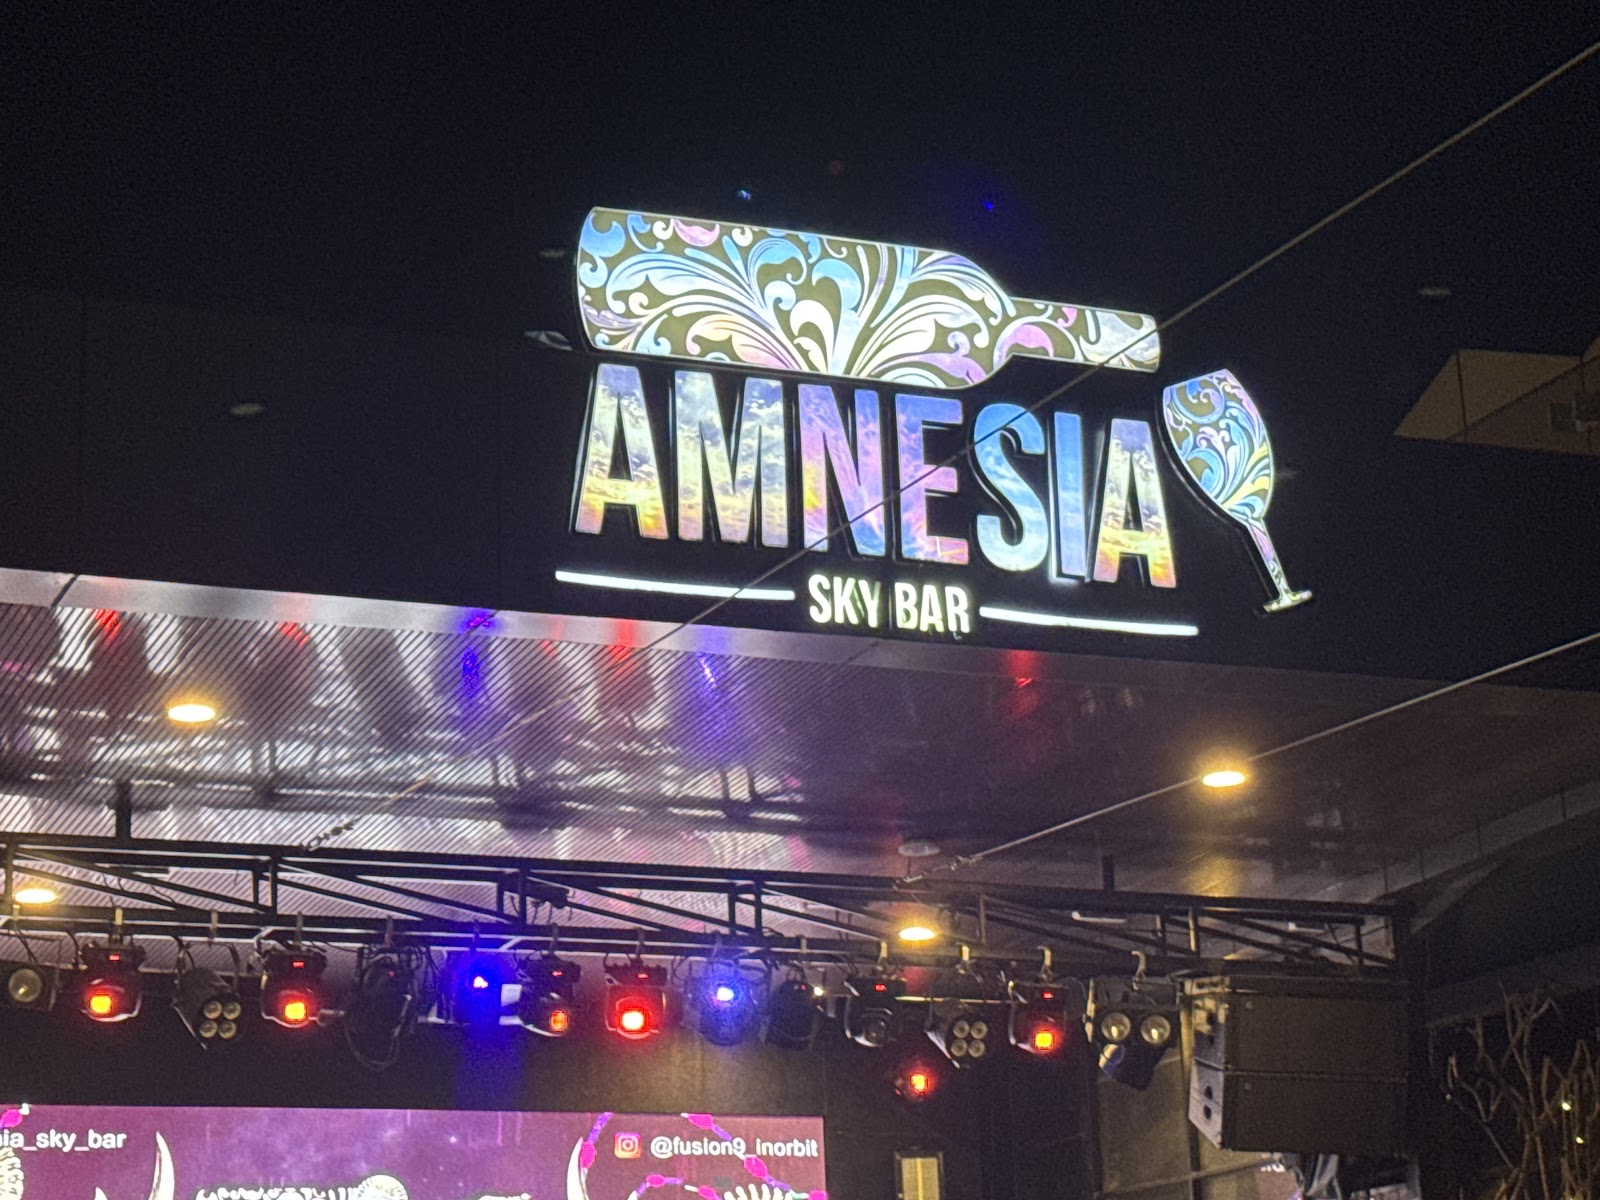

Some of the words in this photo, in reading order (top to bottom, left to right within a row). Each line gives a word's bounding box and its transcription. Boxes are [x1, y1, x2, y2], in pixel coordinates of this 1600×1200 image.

[571, 362, 1178, 589] AMNESIA
[808, 573, 884, 629] SKY
[893, 581, 971, 634] BAR
[0, 1128, 127, 1153] ia_sky_bar
[650, 1135, 819, 1160] @fusion9_inorbit
